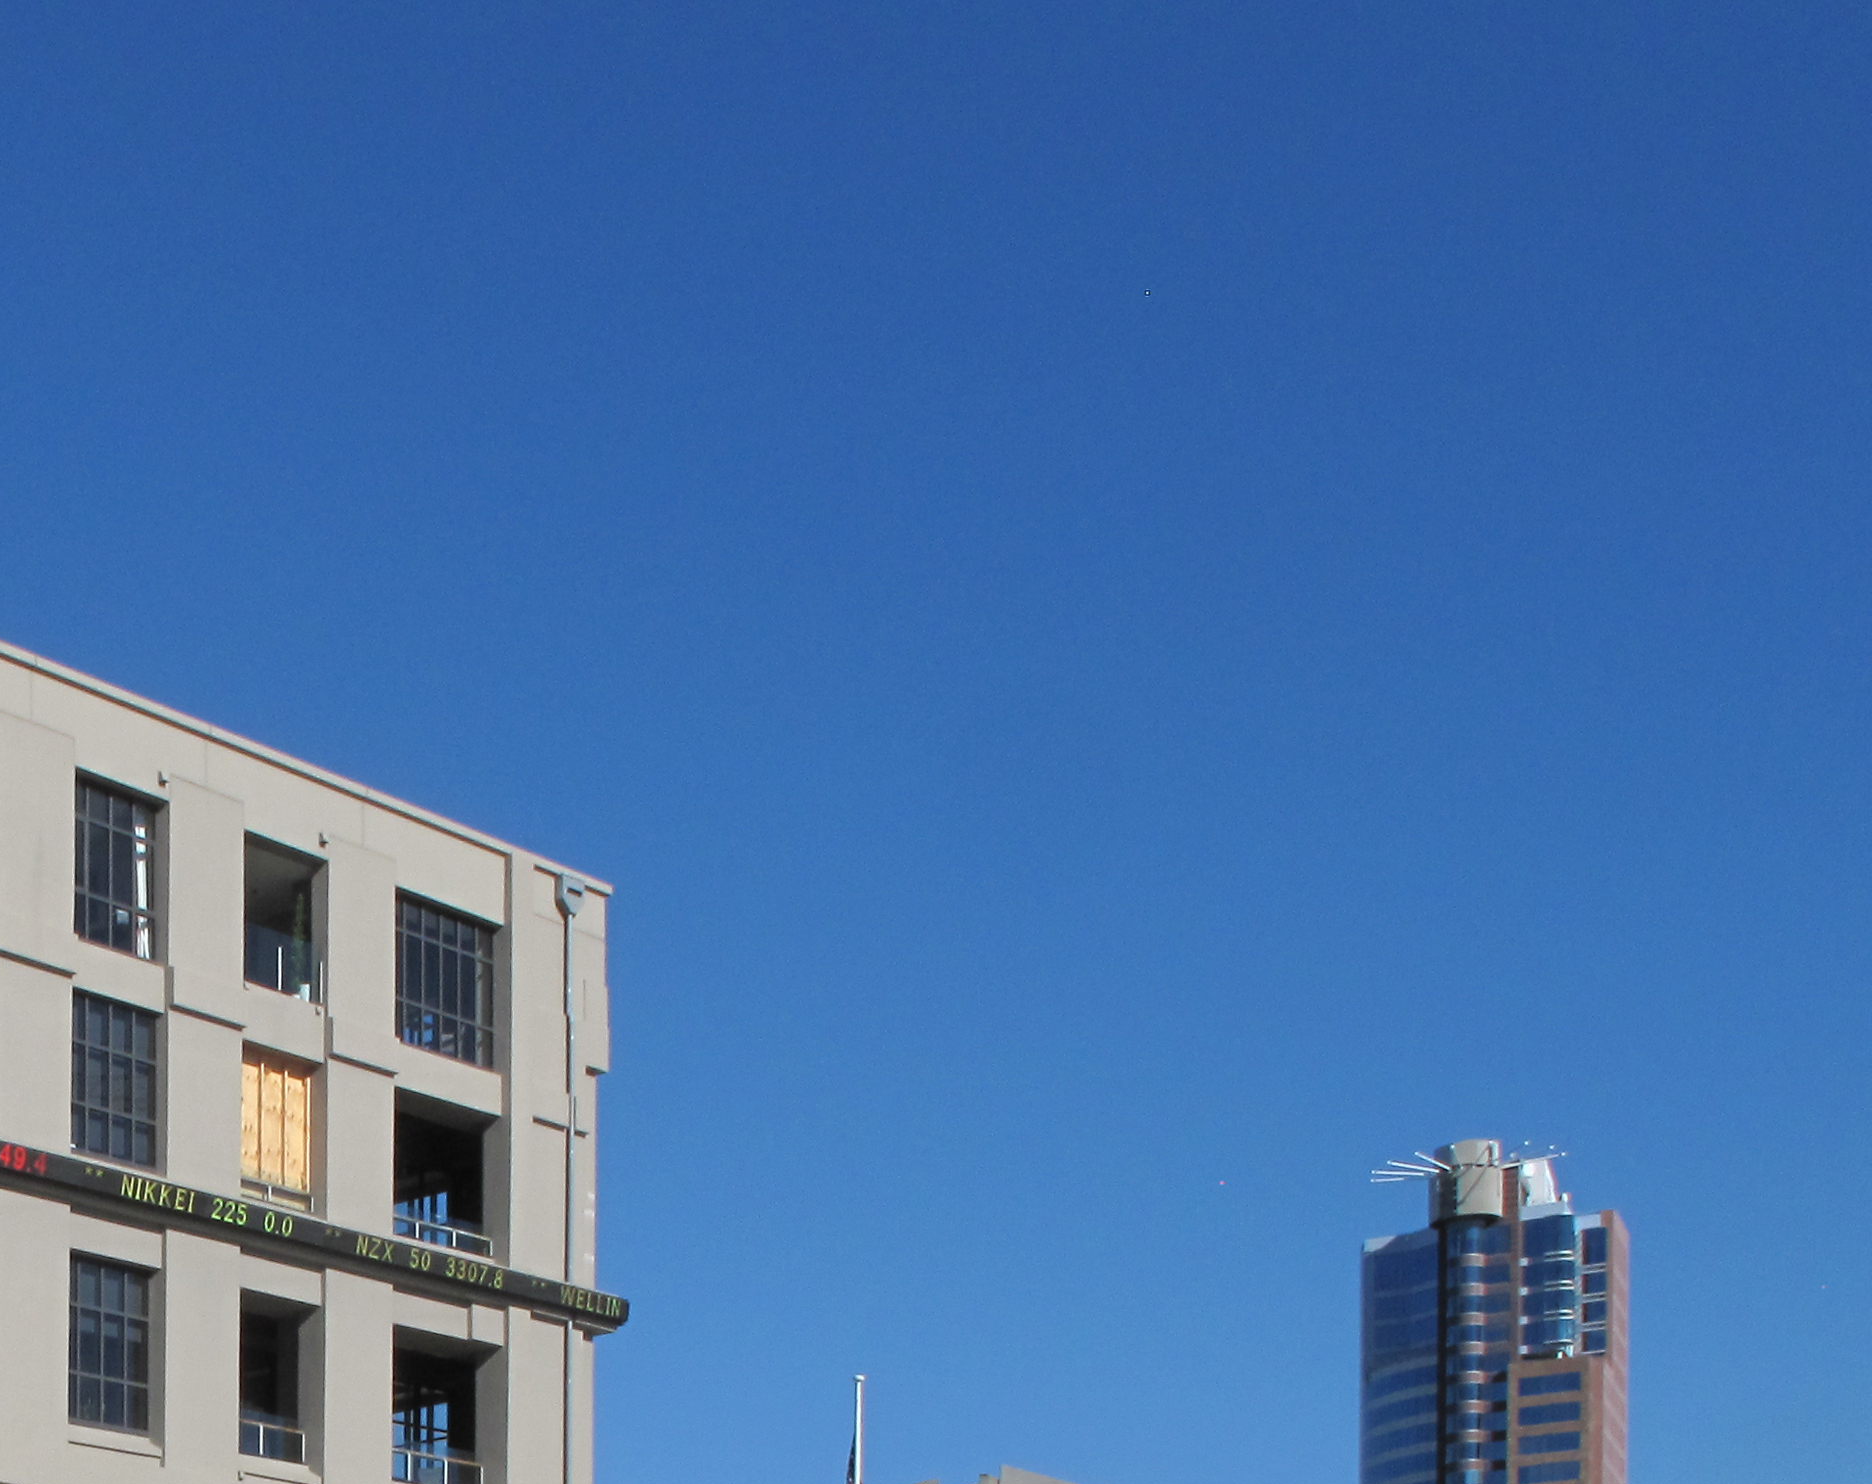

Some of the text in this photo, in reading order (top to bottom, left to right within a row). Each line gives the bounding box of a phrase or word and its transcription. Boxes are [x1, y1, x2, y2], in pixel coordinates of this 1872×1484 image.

[120, 1174, 195, 1213] NIKKEI
[210, 1198, 247, 1226] 225
[264, 1211, 294, 1237] 0.0
[355, 1234, 394, 1263] NZX
[409, 1247, 431, 1271] 50
[444, 1257, 503, 1289] 3307.8
